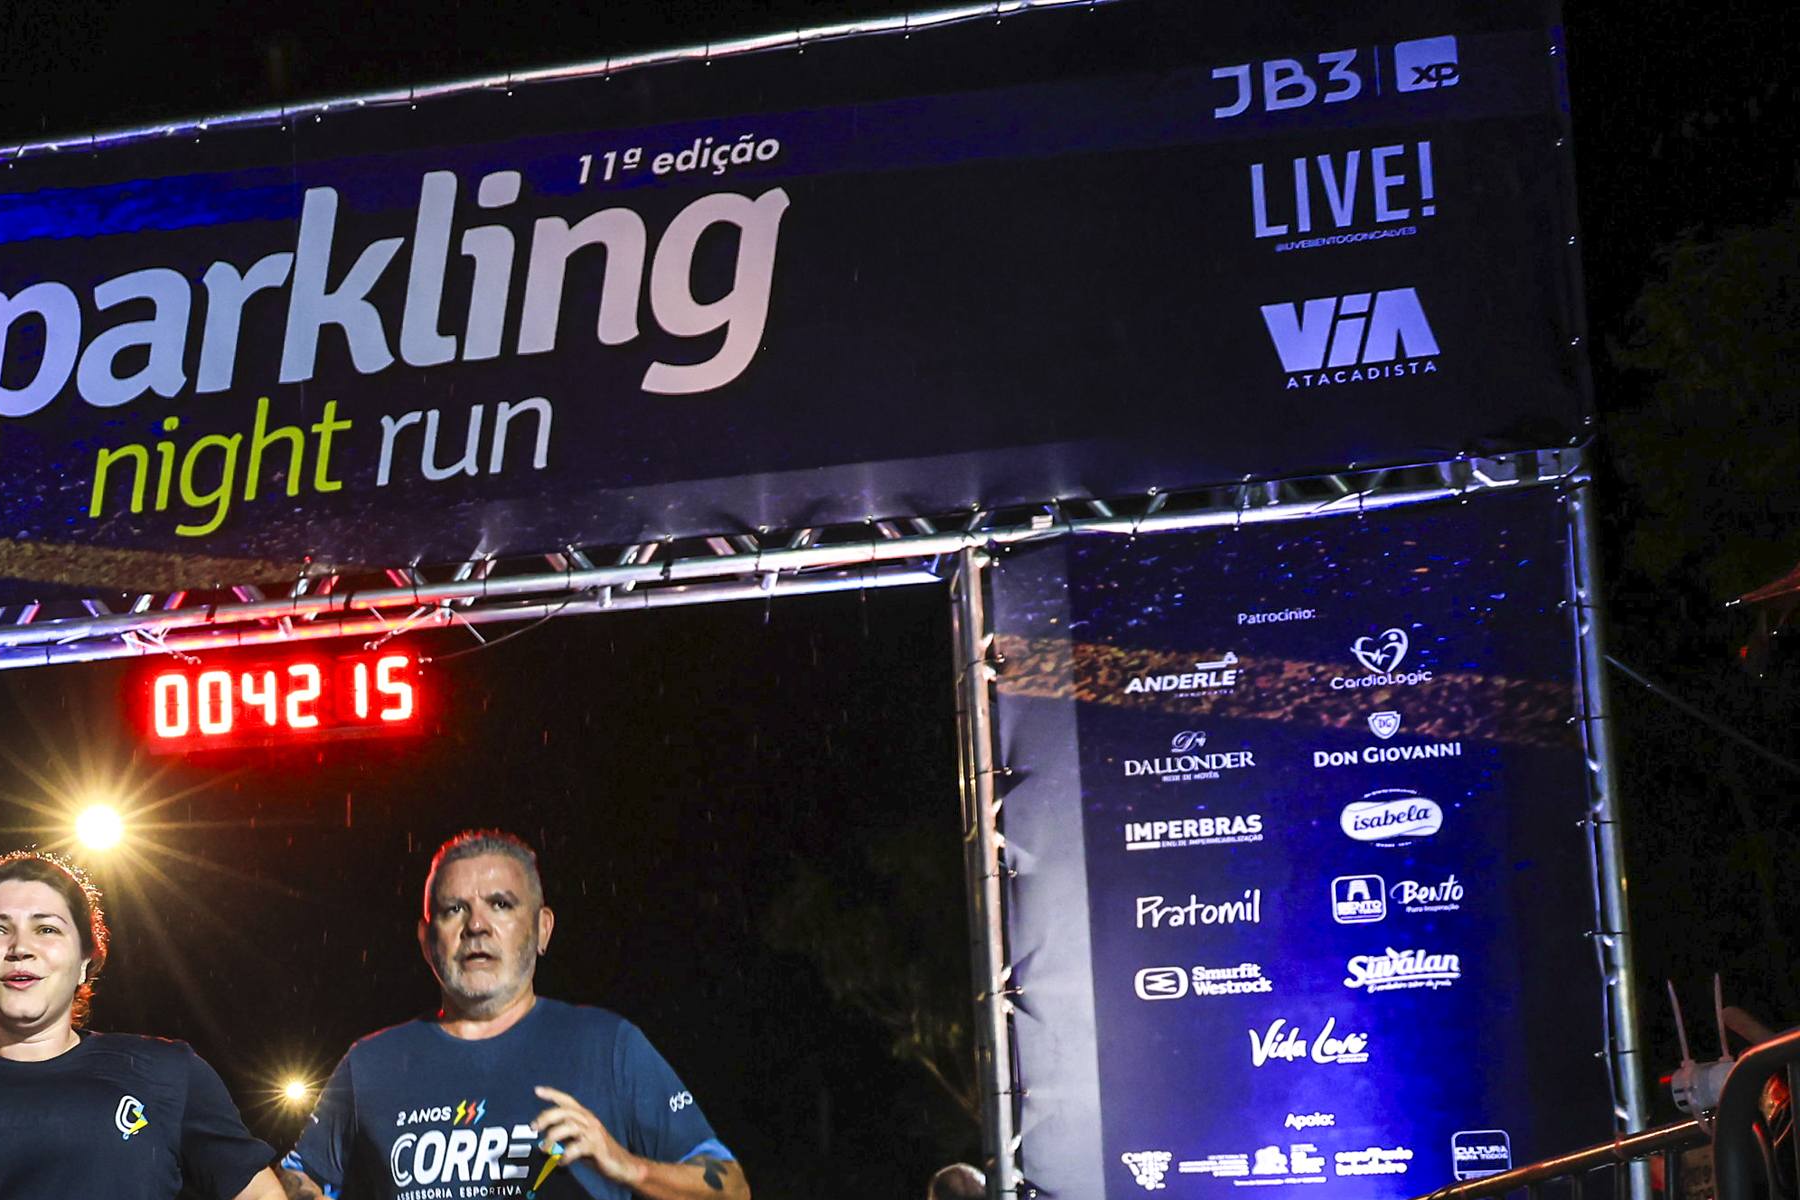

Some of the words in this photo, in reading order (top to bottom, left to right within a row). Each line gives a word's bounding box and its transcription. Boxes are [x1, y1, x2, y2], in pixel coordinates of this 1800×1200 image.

[1212, 48, 1362, 119] JB3
[649, 136, 780, 183] edição
[1251, 141, 1436, 238] LIVE!
[1286, 360, 1438, 389] ATACADISTA
[89, 397, 352, 537] night
[375, 396, 552, 487] run
[1237, 608, 1316, 626] Patrocínio:
[1125, 670, 1237, 694] ANDERLE
[1314, 748, 1358, 768] DON
[1363, 742, 1462, 765] GIOVANNI
[1125, 815, 1262, 842] IMPERBRAS
[1353, 804, 1431, 832] isabela
[1390, 875, 1464, 906] Bento
[1136, 889, 1261, 928] Pratomil
[1192, 963, 1261, 980] Smurfit
[1192, 977, 1273, 996] Westrock
[1249, 1019, 1307, 1068] Vida
[397, 1111, 407, 1126] 2
[408, 1106, 452, 1124] ANOS
[390, 1124, 538, 1187] CORRE
[459, 1185, 522, 1199] ESPORTIVA
